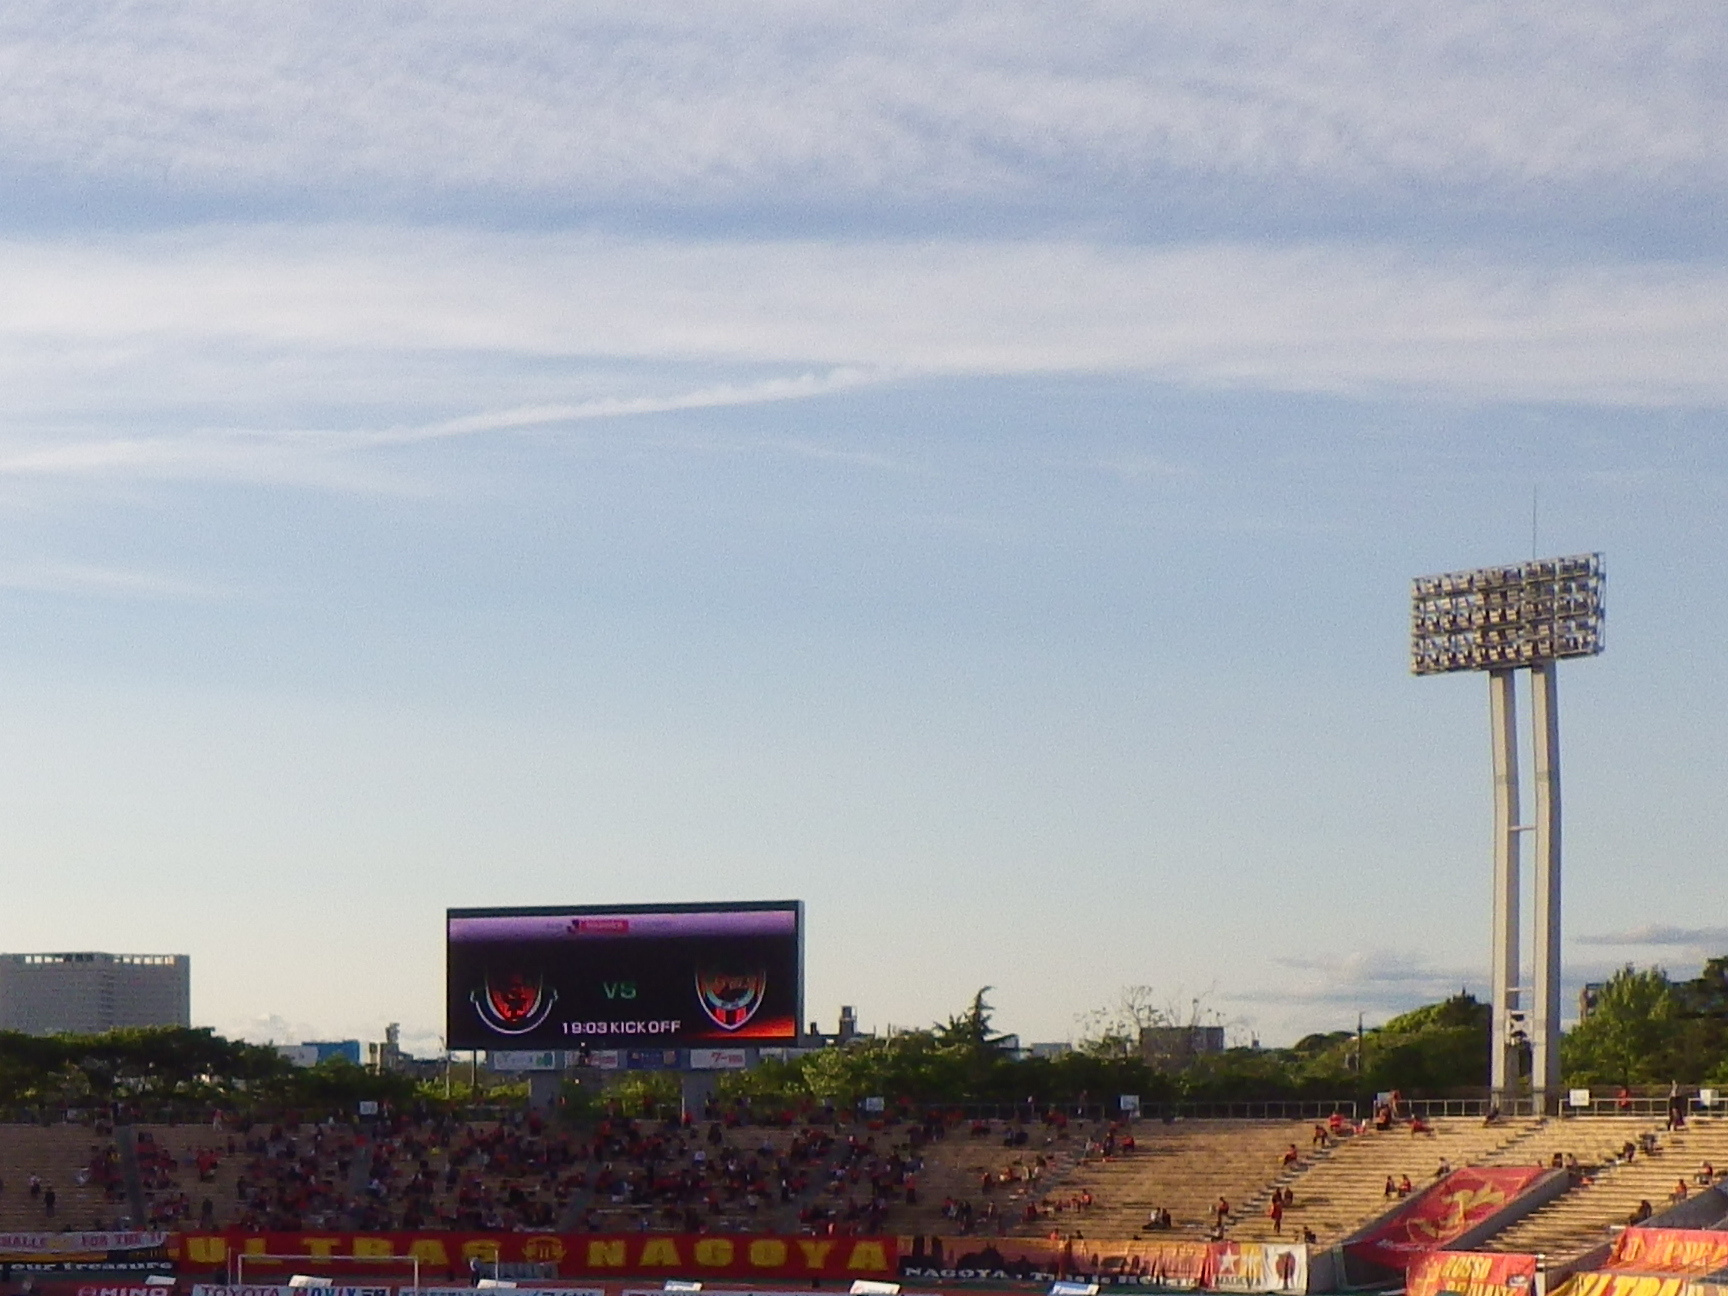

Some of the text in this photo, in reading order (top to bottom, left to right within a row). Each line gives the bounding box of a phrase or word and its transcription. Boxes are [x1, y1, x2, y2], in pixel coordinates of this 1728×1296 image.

[603, 981, 637, 999] VS
[610, 1022, 647, 1034] KICK
[648, 1020, 681, 1034] OFF
[586, 1237, 890, 1271] NAGOYA
